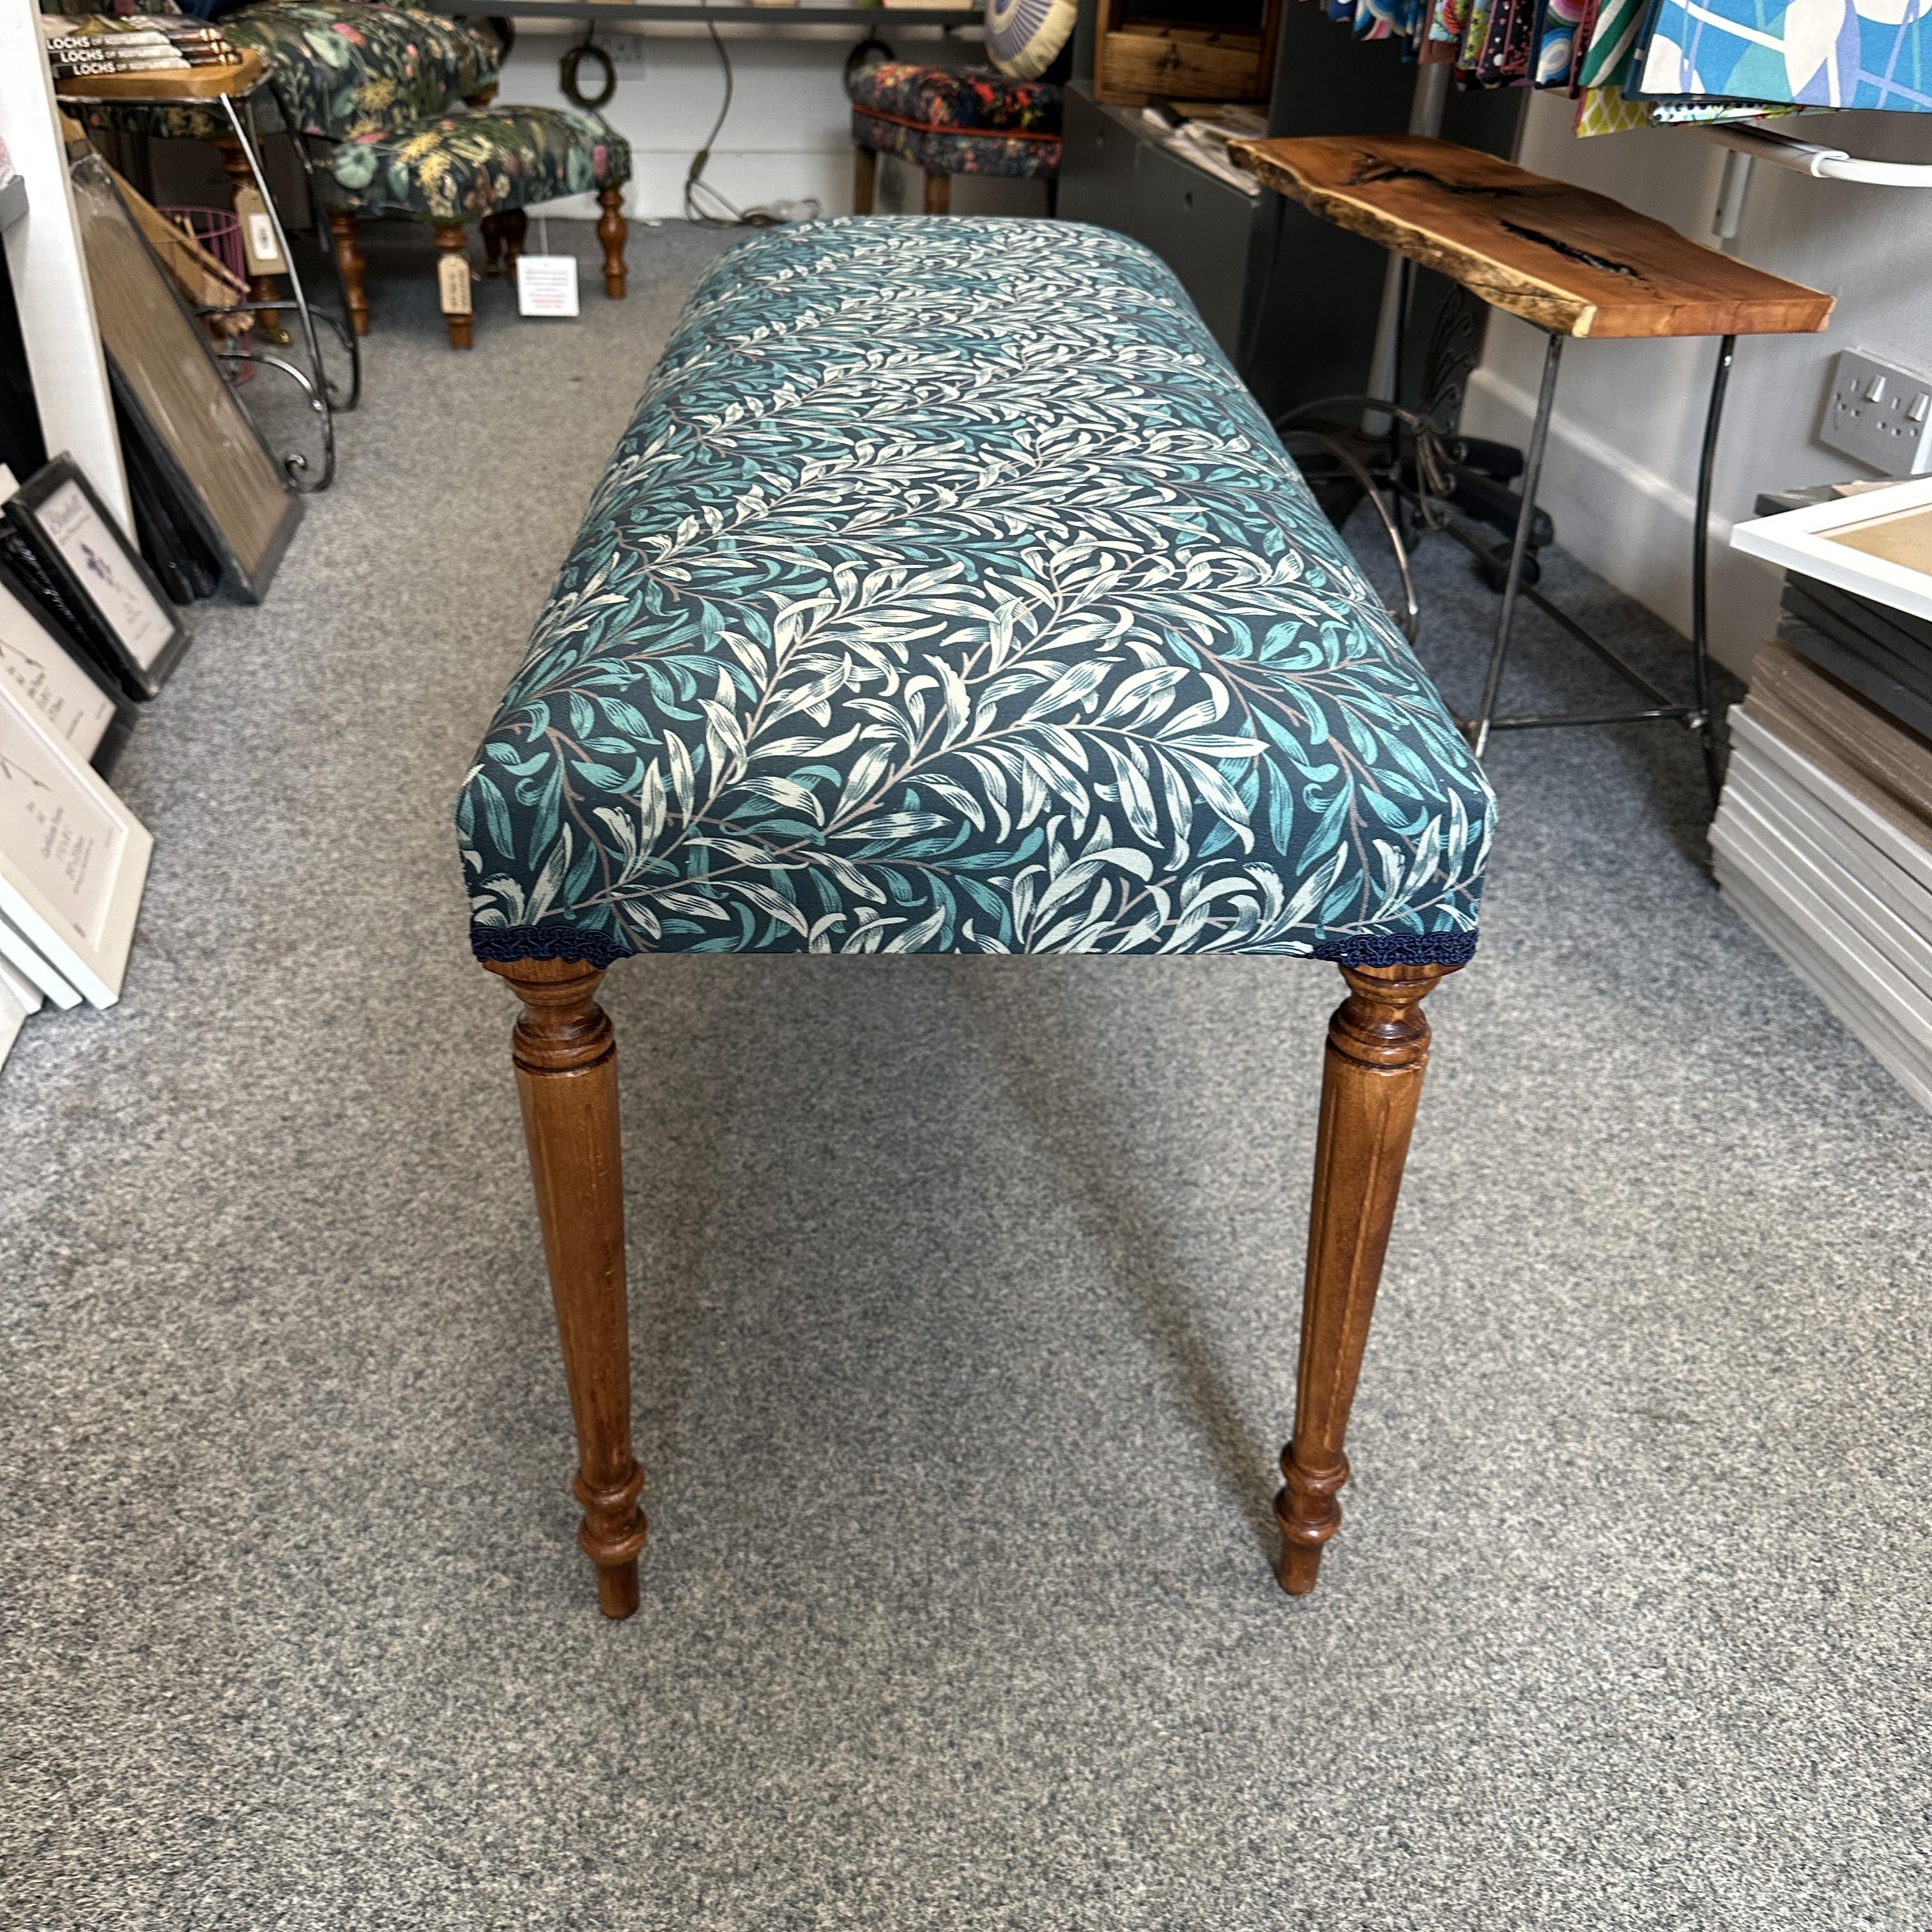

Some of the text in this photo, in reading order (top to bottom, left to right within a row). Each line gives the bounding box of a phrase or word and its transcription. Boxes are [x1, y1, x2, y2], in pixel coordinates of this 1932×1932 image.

[46, 36, 90, 50] LOCHS
[60, 49, 104, 63] LOCHS
[73, 62, 115, 75] LOCHS
